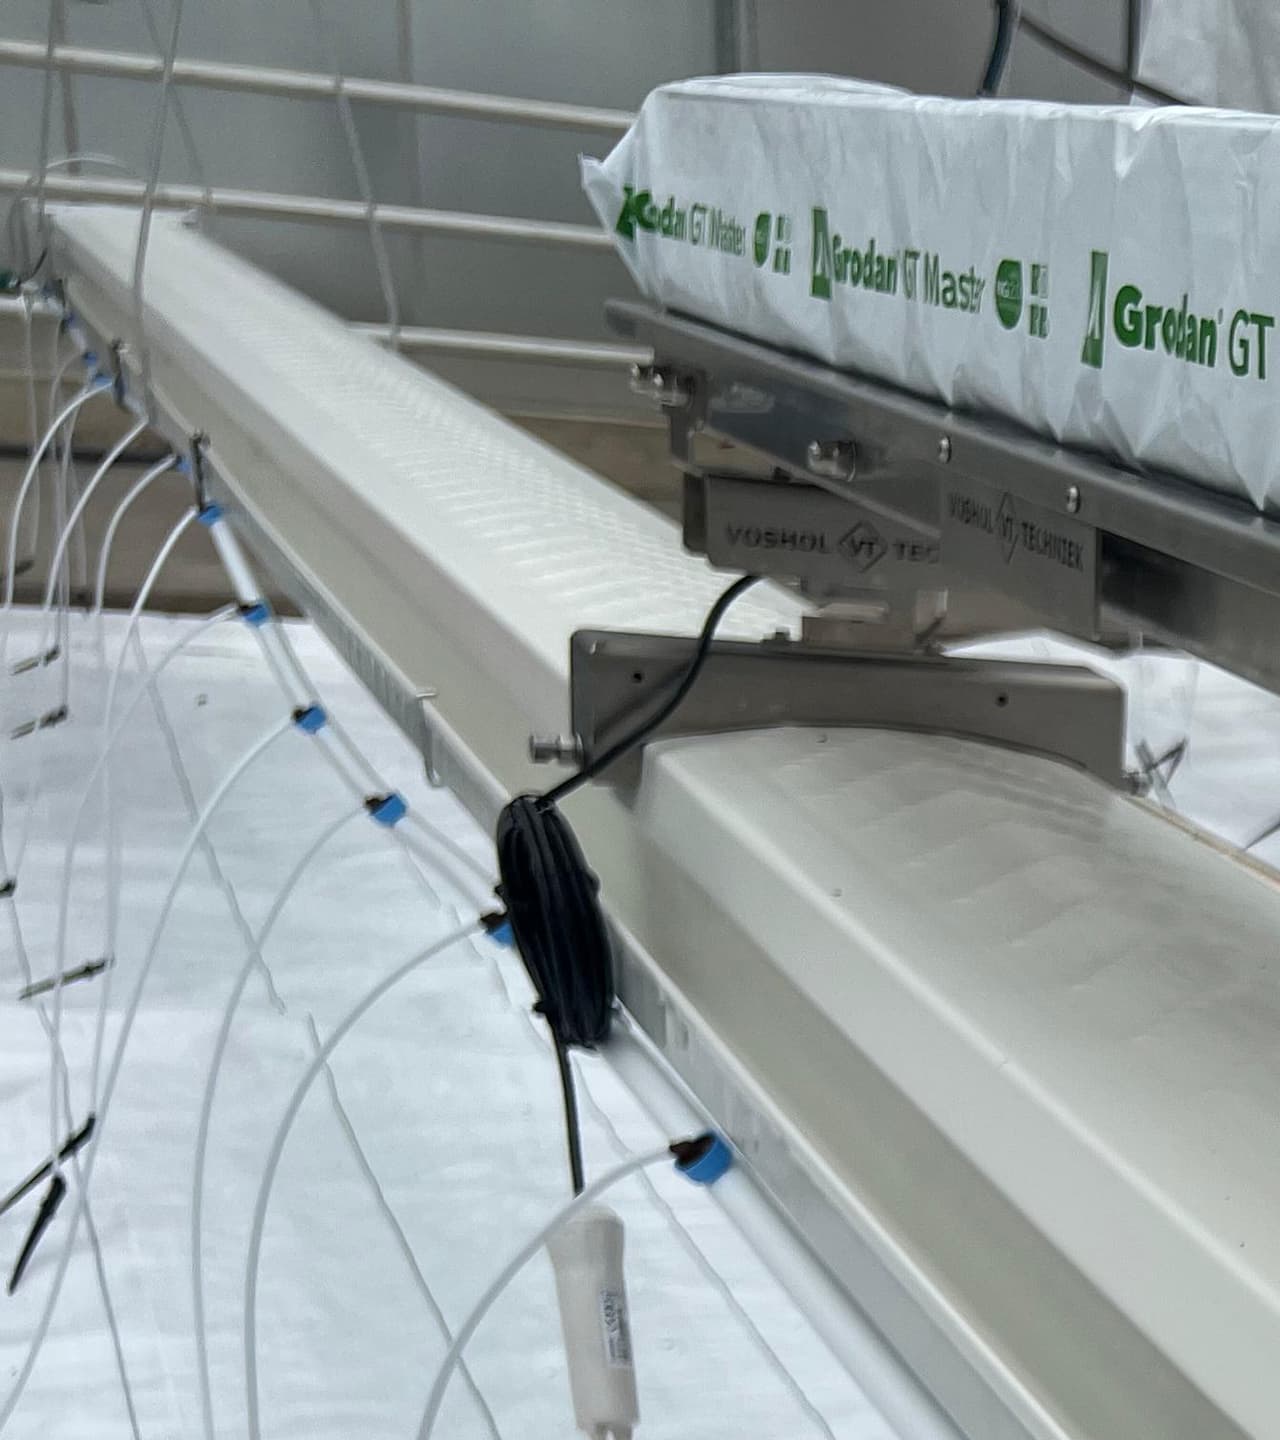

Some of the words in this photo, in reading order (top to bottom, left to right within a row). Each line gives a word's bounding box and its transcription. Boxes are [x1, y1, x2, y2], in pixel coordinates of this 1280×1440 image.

[1228, 308, 1275, 380] GT
[727, 522, 831, 554] VOSHOL
[1022, 520, 1084, 573] TECHNIEK
